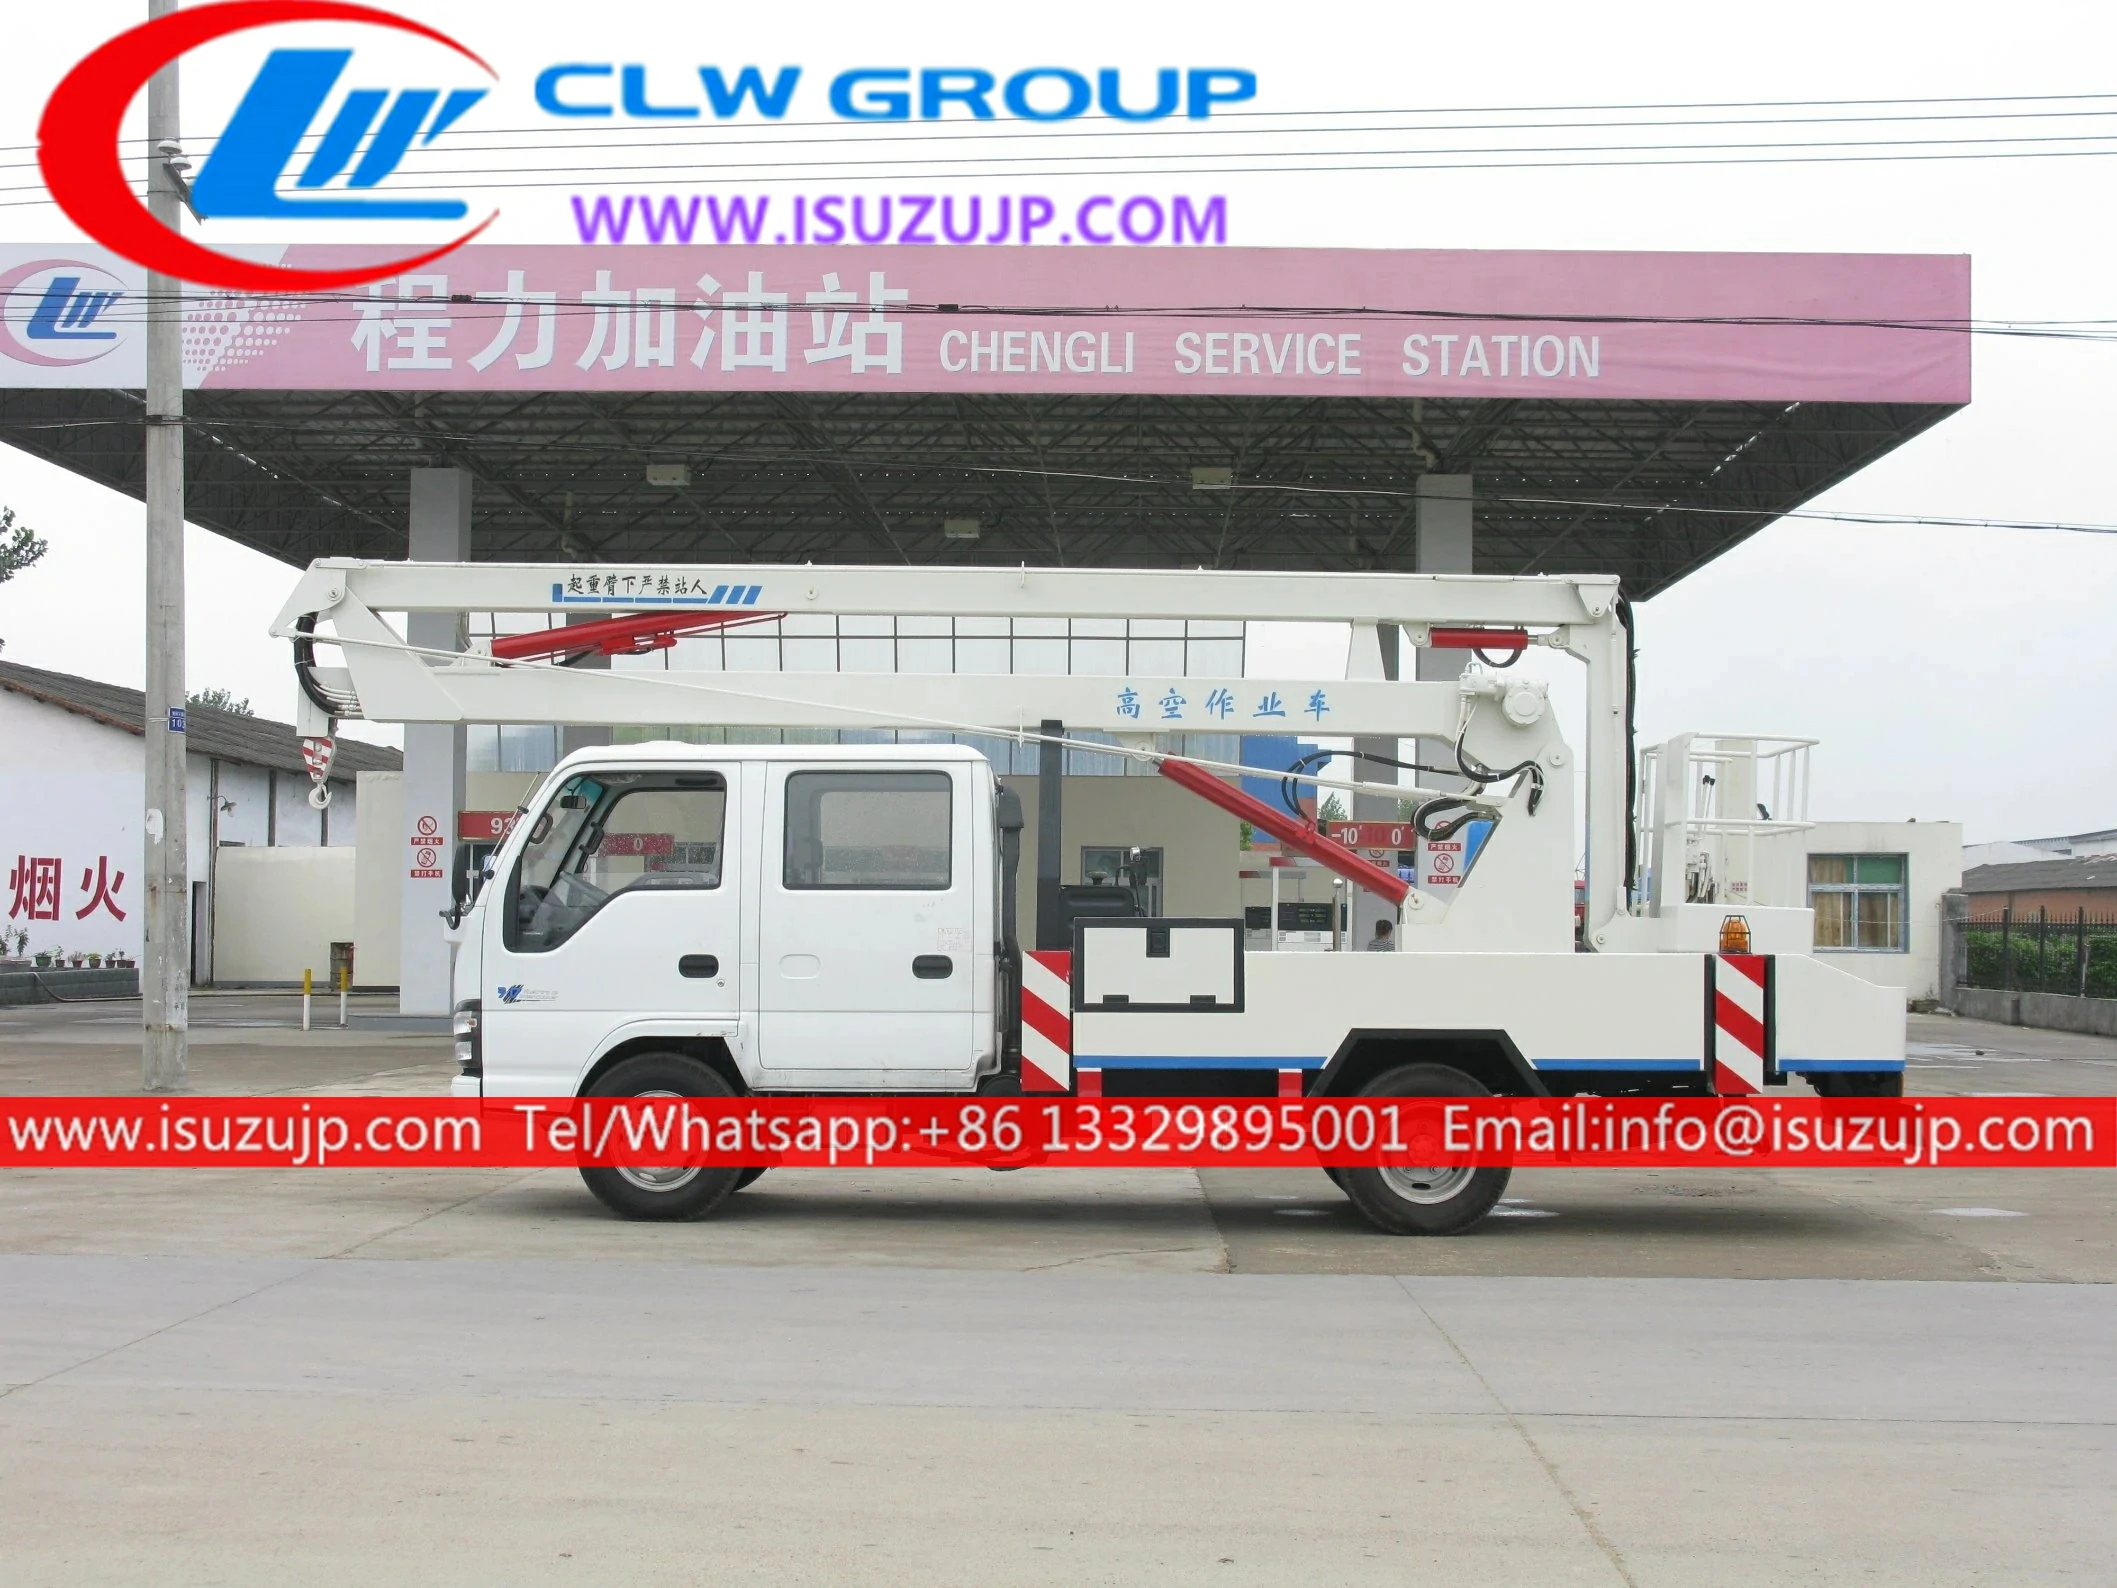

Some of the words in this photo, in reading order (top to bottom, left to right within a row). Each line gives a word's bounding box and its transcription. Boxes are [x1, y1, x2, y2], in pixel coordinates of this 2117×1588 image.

[350, 269, 909, 374] 程力加油站
[939, 329, 1135, 374] CHENGLI
[1174, 331, 1362, 376] SERVICE
[1402, 333, 1600, 378] STATION
[566, 573, 708, 597] 起重臂下严禁站人
[1116, 686, 1331, 722] 高空作业车
[8, 854, 127, 922] 烟火
